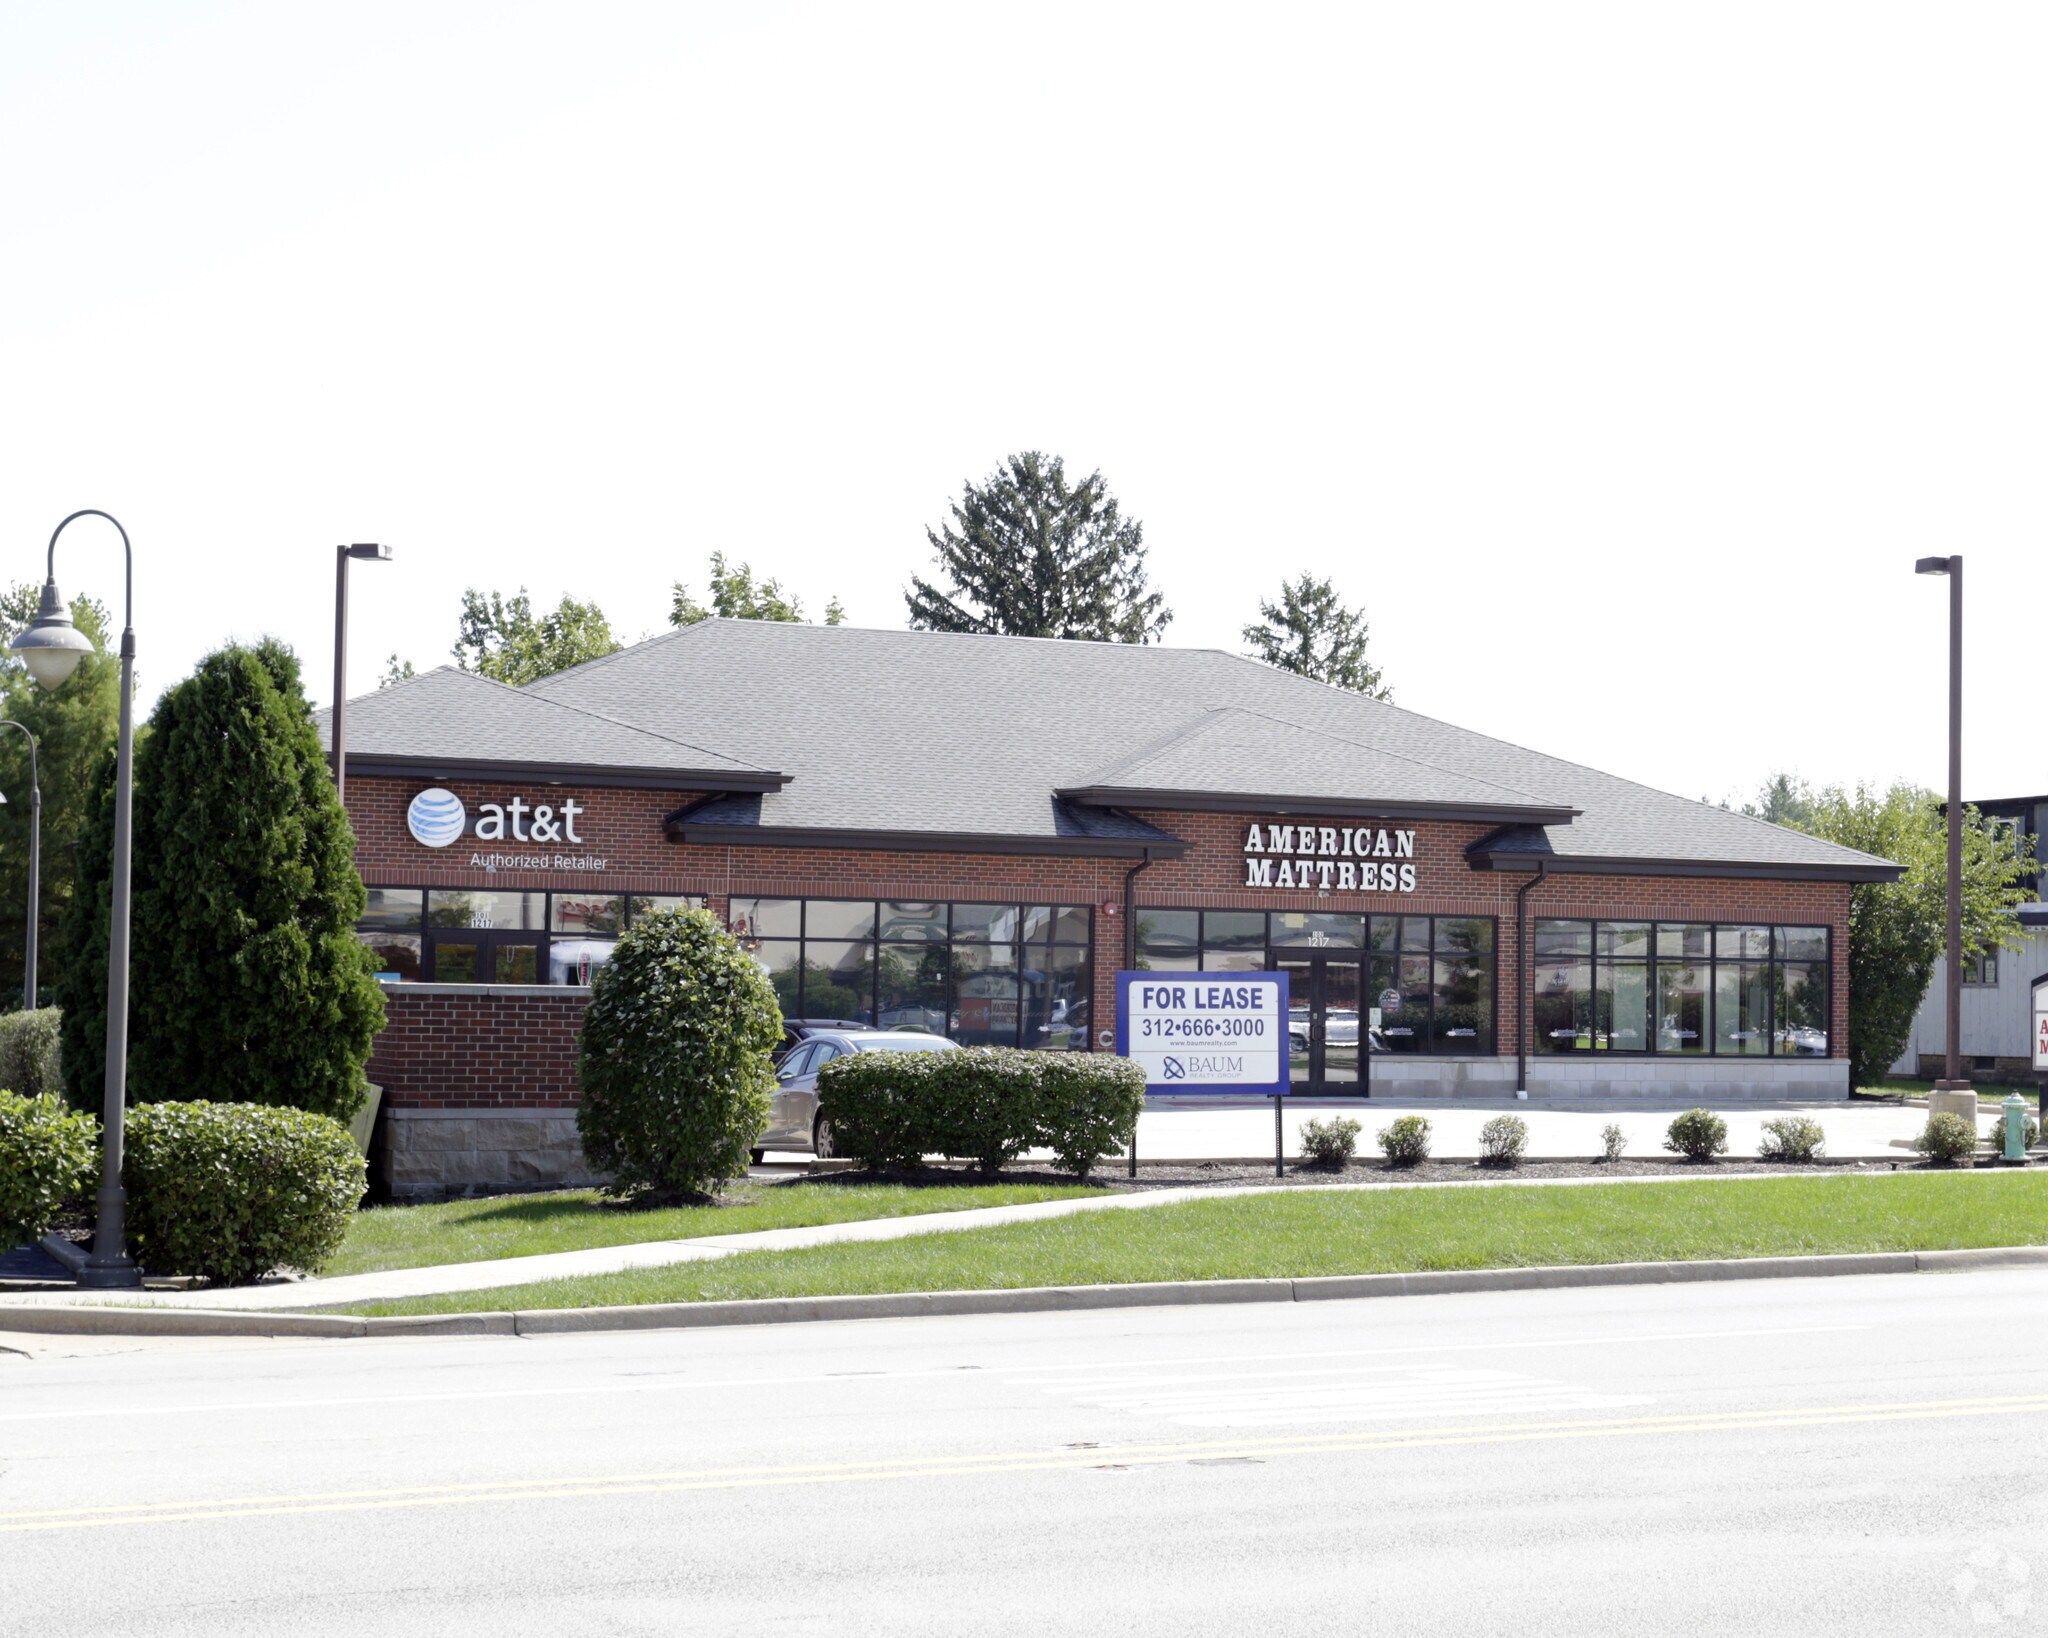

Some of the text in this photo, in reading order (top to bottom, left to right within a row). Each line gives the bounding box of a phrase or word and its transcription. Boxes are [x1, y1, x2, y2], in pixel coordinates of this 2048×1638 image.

[475, 796, 583, 844] at&t
[1244, 823, 1416, 858] AMERICAN
[470, 852, 609, 870] Authorized Retailer
[1245, 858, 1416, 892] MATTRESS
[472, 919, 493, 928] 1217
[1308, 936, 1330, 947] 1217
[1143, 987, 1263, 1009] FOR LEASE
[1170, 1040, 1238, 1048] www.baumrealty.com
[1188, 1056, 1243, 1072] BAUM
